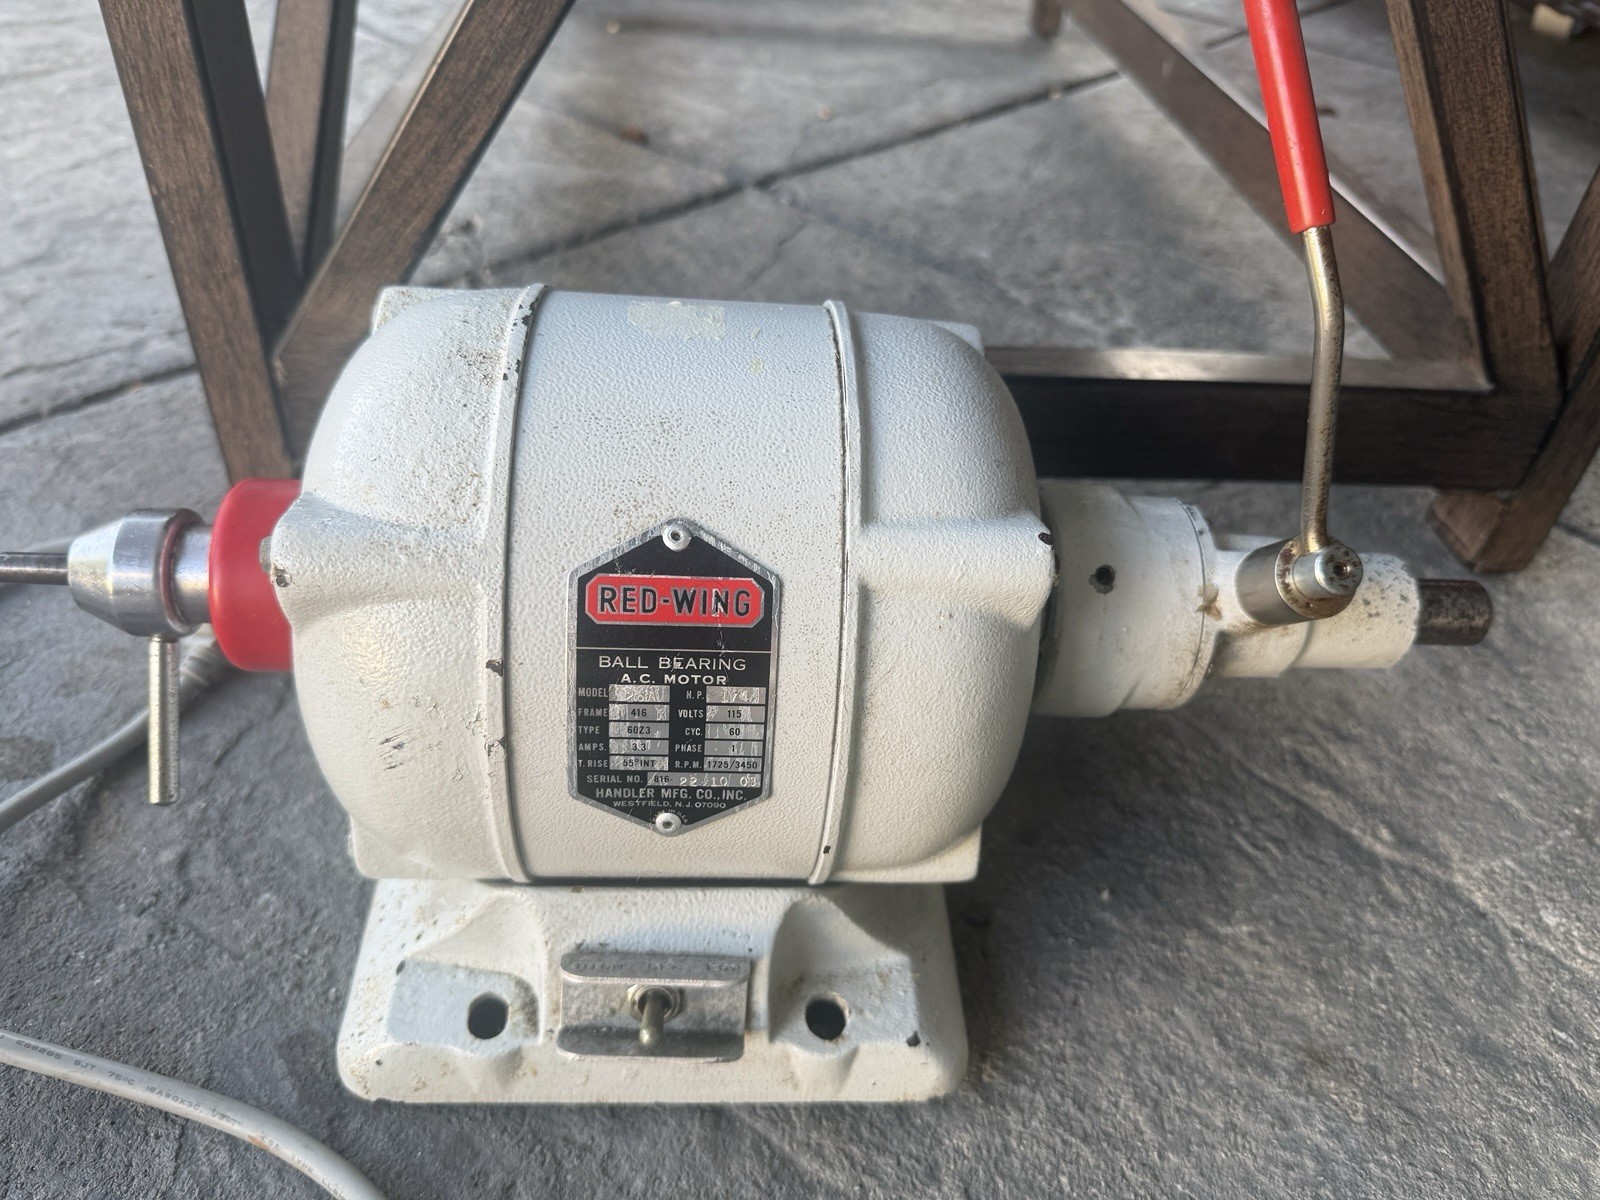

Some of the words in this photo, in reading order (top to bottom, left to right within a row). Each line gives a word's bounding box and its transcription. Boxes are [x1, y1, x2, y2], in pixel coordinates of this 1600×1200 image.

[598, 585, 752, 617] RED-WING
[599, 655, 649, 669] BALL
[658, 656, 746, 671] BEARING
[620, 673, 656, 684] A.C.
[664, 674, 727, 685] MOTOR
[577, 687, 608, 698] MODEL
[686, 690, 705, 700] H.P.
[577, 707, 608, 718] FRAME
[630, 708, 647, 718] 416
[678, 708, 704, 718] VOLTS
[727, 709, 742, 719] 115
[577, 726, 600, 735] TYPE
[627, 724, 651, 735] 60Z3
[684, 726, 703, 737] CYC.
[729, 726, 741, 737] 60
[578, 743, 607, 752] AMPS.
[675, 744, 703, 753] PHASE
[731, 743, 736, 754] 1
[578, 759, 586, 768] T.
[587, 759, 608, 768] RISE
[674, 762, 703, 771] R.P.M.
[706, 760, 758, 773] 1725/3450
[586, 774, 622, 784] SERIAL
[626, 775, 643, 784] NO.
[595, 787, 655, 799] HANDLER
[660, 788, 692, 800] MFG.
[73, 1060, 97, 1071] SJT
